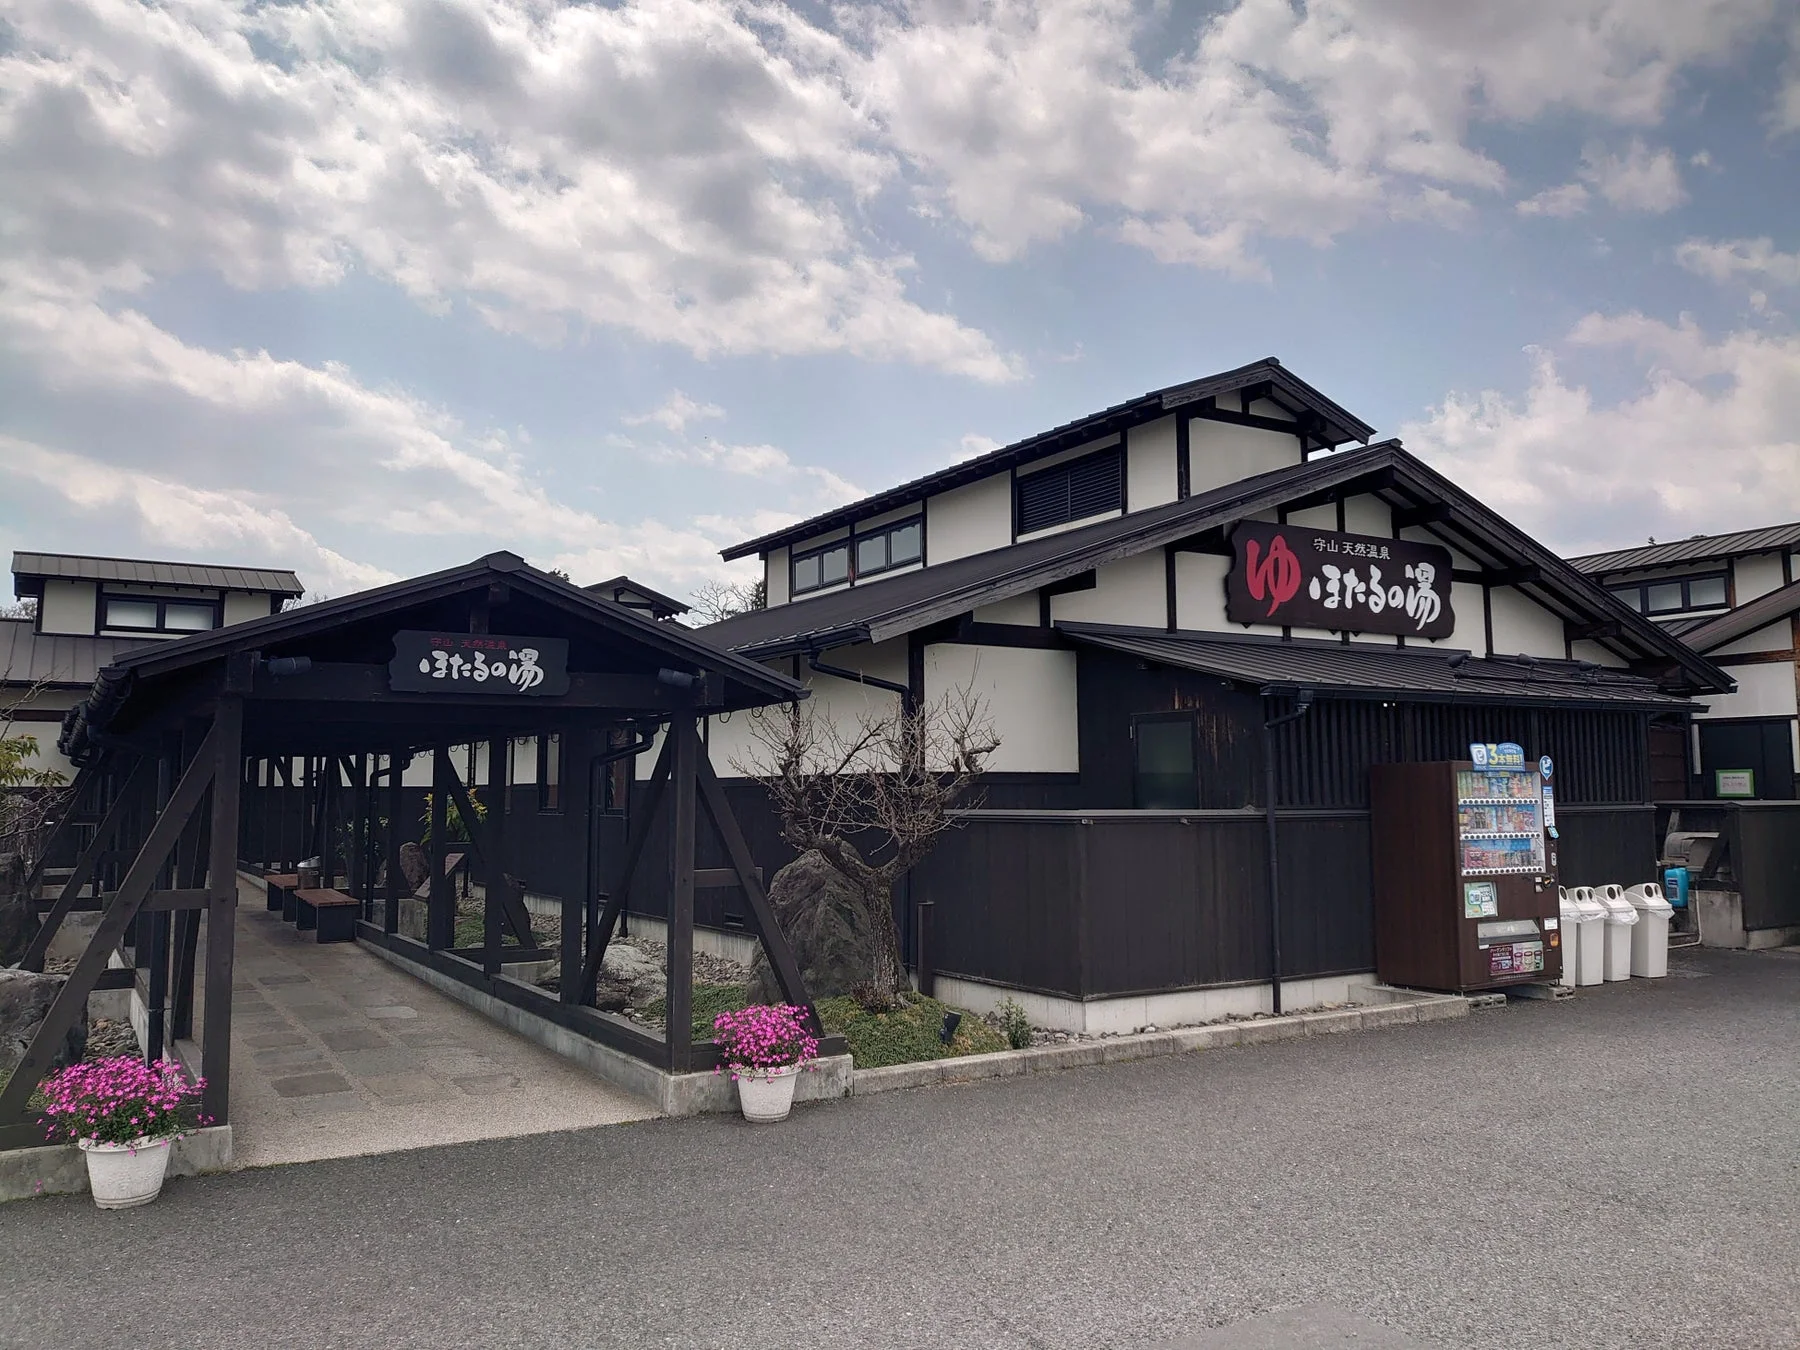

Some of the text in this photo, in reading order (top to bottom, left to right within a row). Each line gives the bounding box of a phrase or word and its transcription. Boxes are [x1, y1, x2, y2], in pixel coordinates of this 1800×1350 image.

[1245, 534, 1302, 618] ゆ
[1313, 537, 1391, 560] 守山 天然温泉
[1308, 562, 1442, 631] ほたるの湯
[418, 648, 545, 693] ほたるの湯
